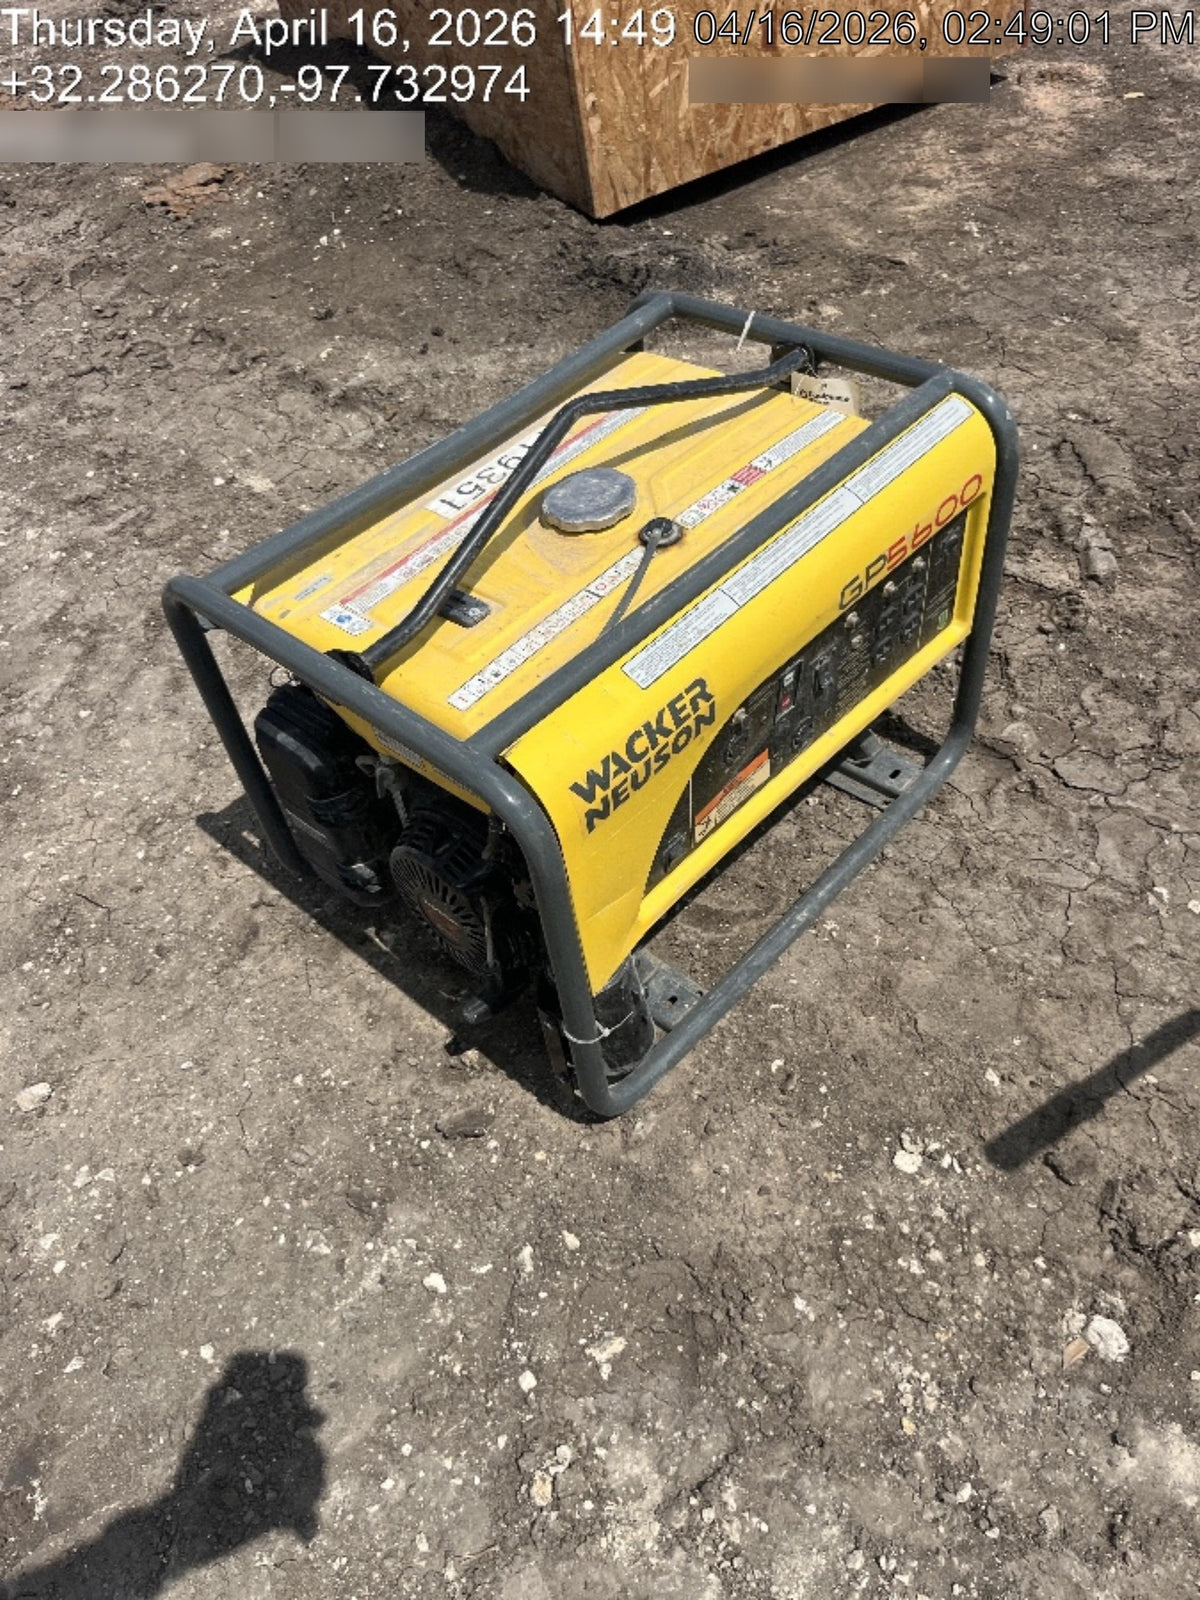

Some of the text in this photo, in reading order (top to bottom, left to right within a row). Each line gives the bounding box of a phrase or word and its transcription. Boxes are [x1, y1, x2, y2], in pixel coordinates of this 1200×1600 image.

[838, 473, 983, 611] GP5600
[568, 676, 715, 804] WACKER
[584, 700, 716, 835] NEUSON
